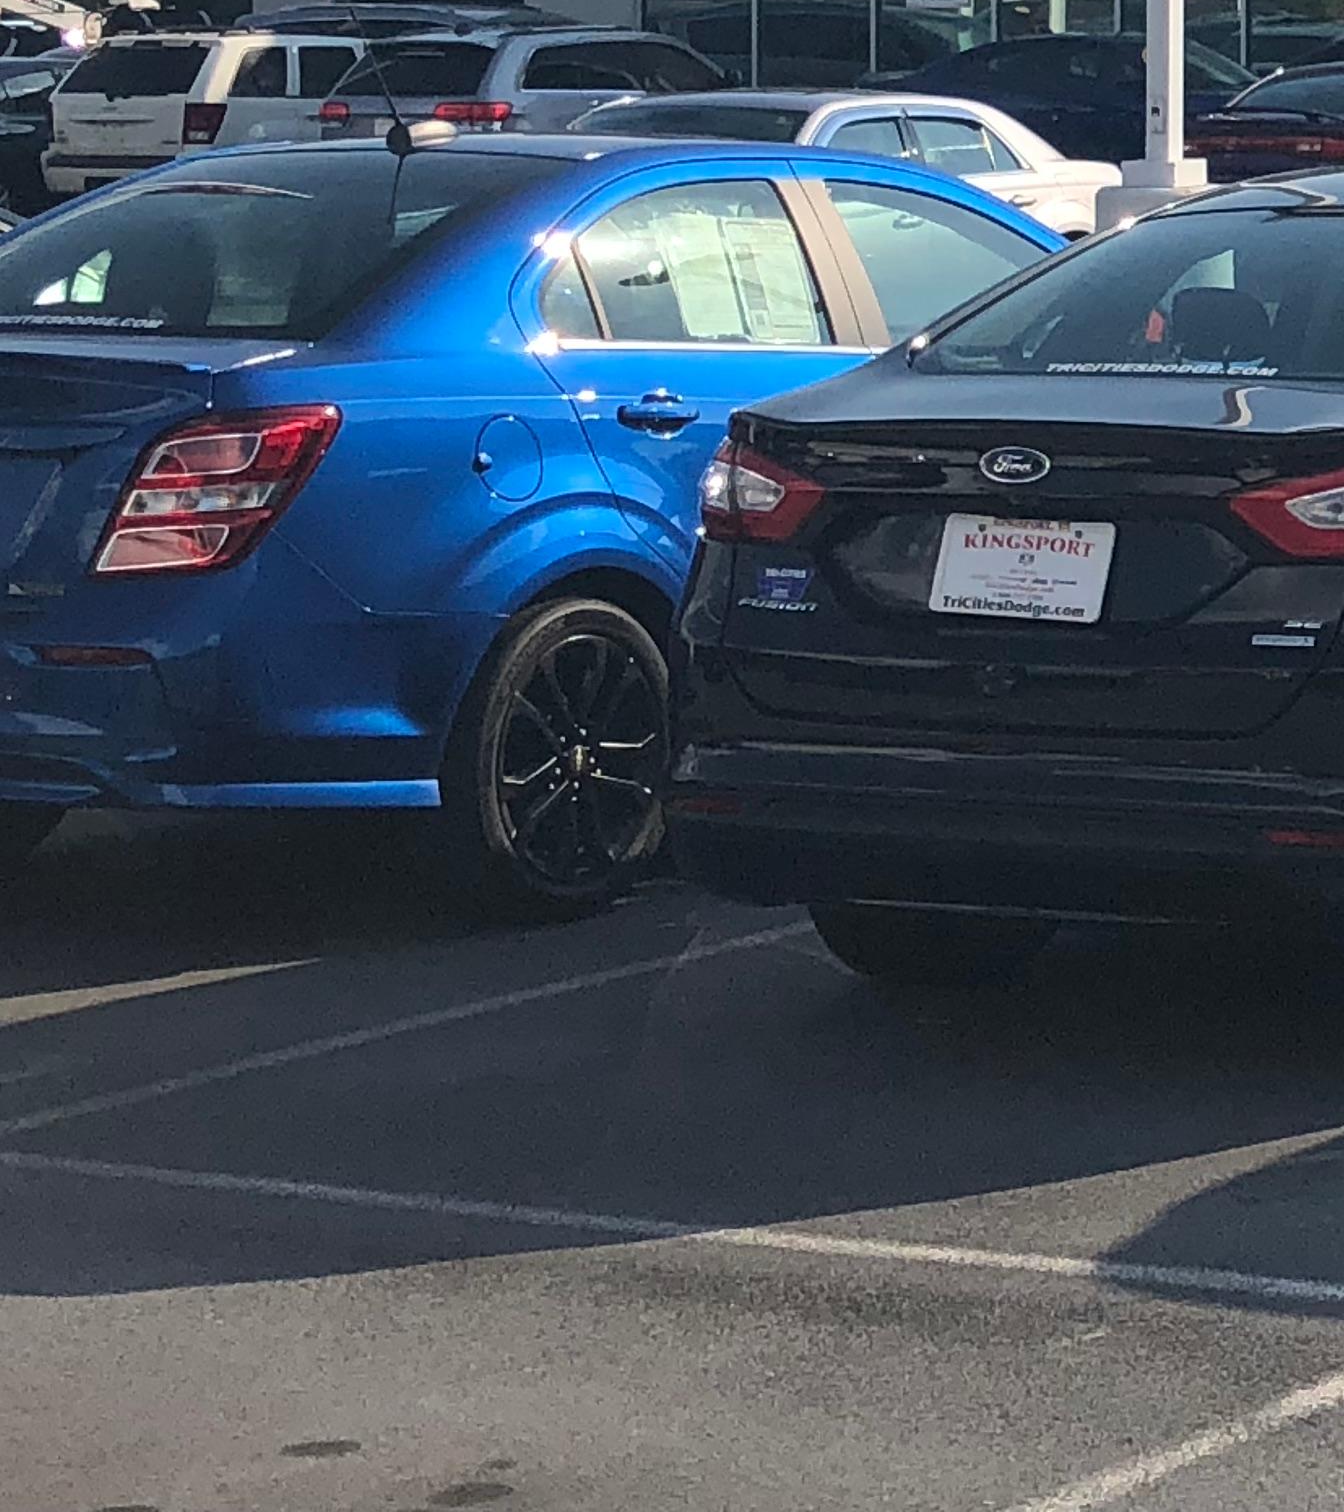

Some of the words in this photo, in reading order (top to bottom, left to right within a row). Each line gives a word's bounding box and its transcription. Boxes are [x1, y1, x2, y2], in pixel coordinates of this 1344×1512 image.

[1046, 362, 1279, 377] TRICITIESDODGE.COM
[993, 454, 1033, 473] Ford
[964, 533, 1096, 558] KINGSPORT
[942, 595, 1086, 618] TriCitiesDodge.com
